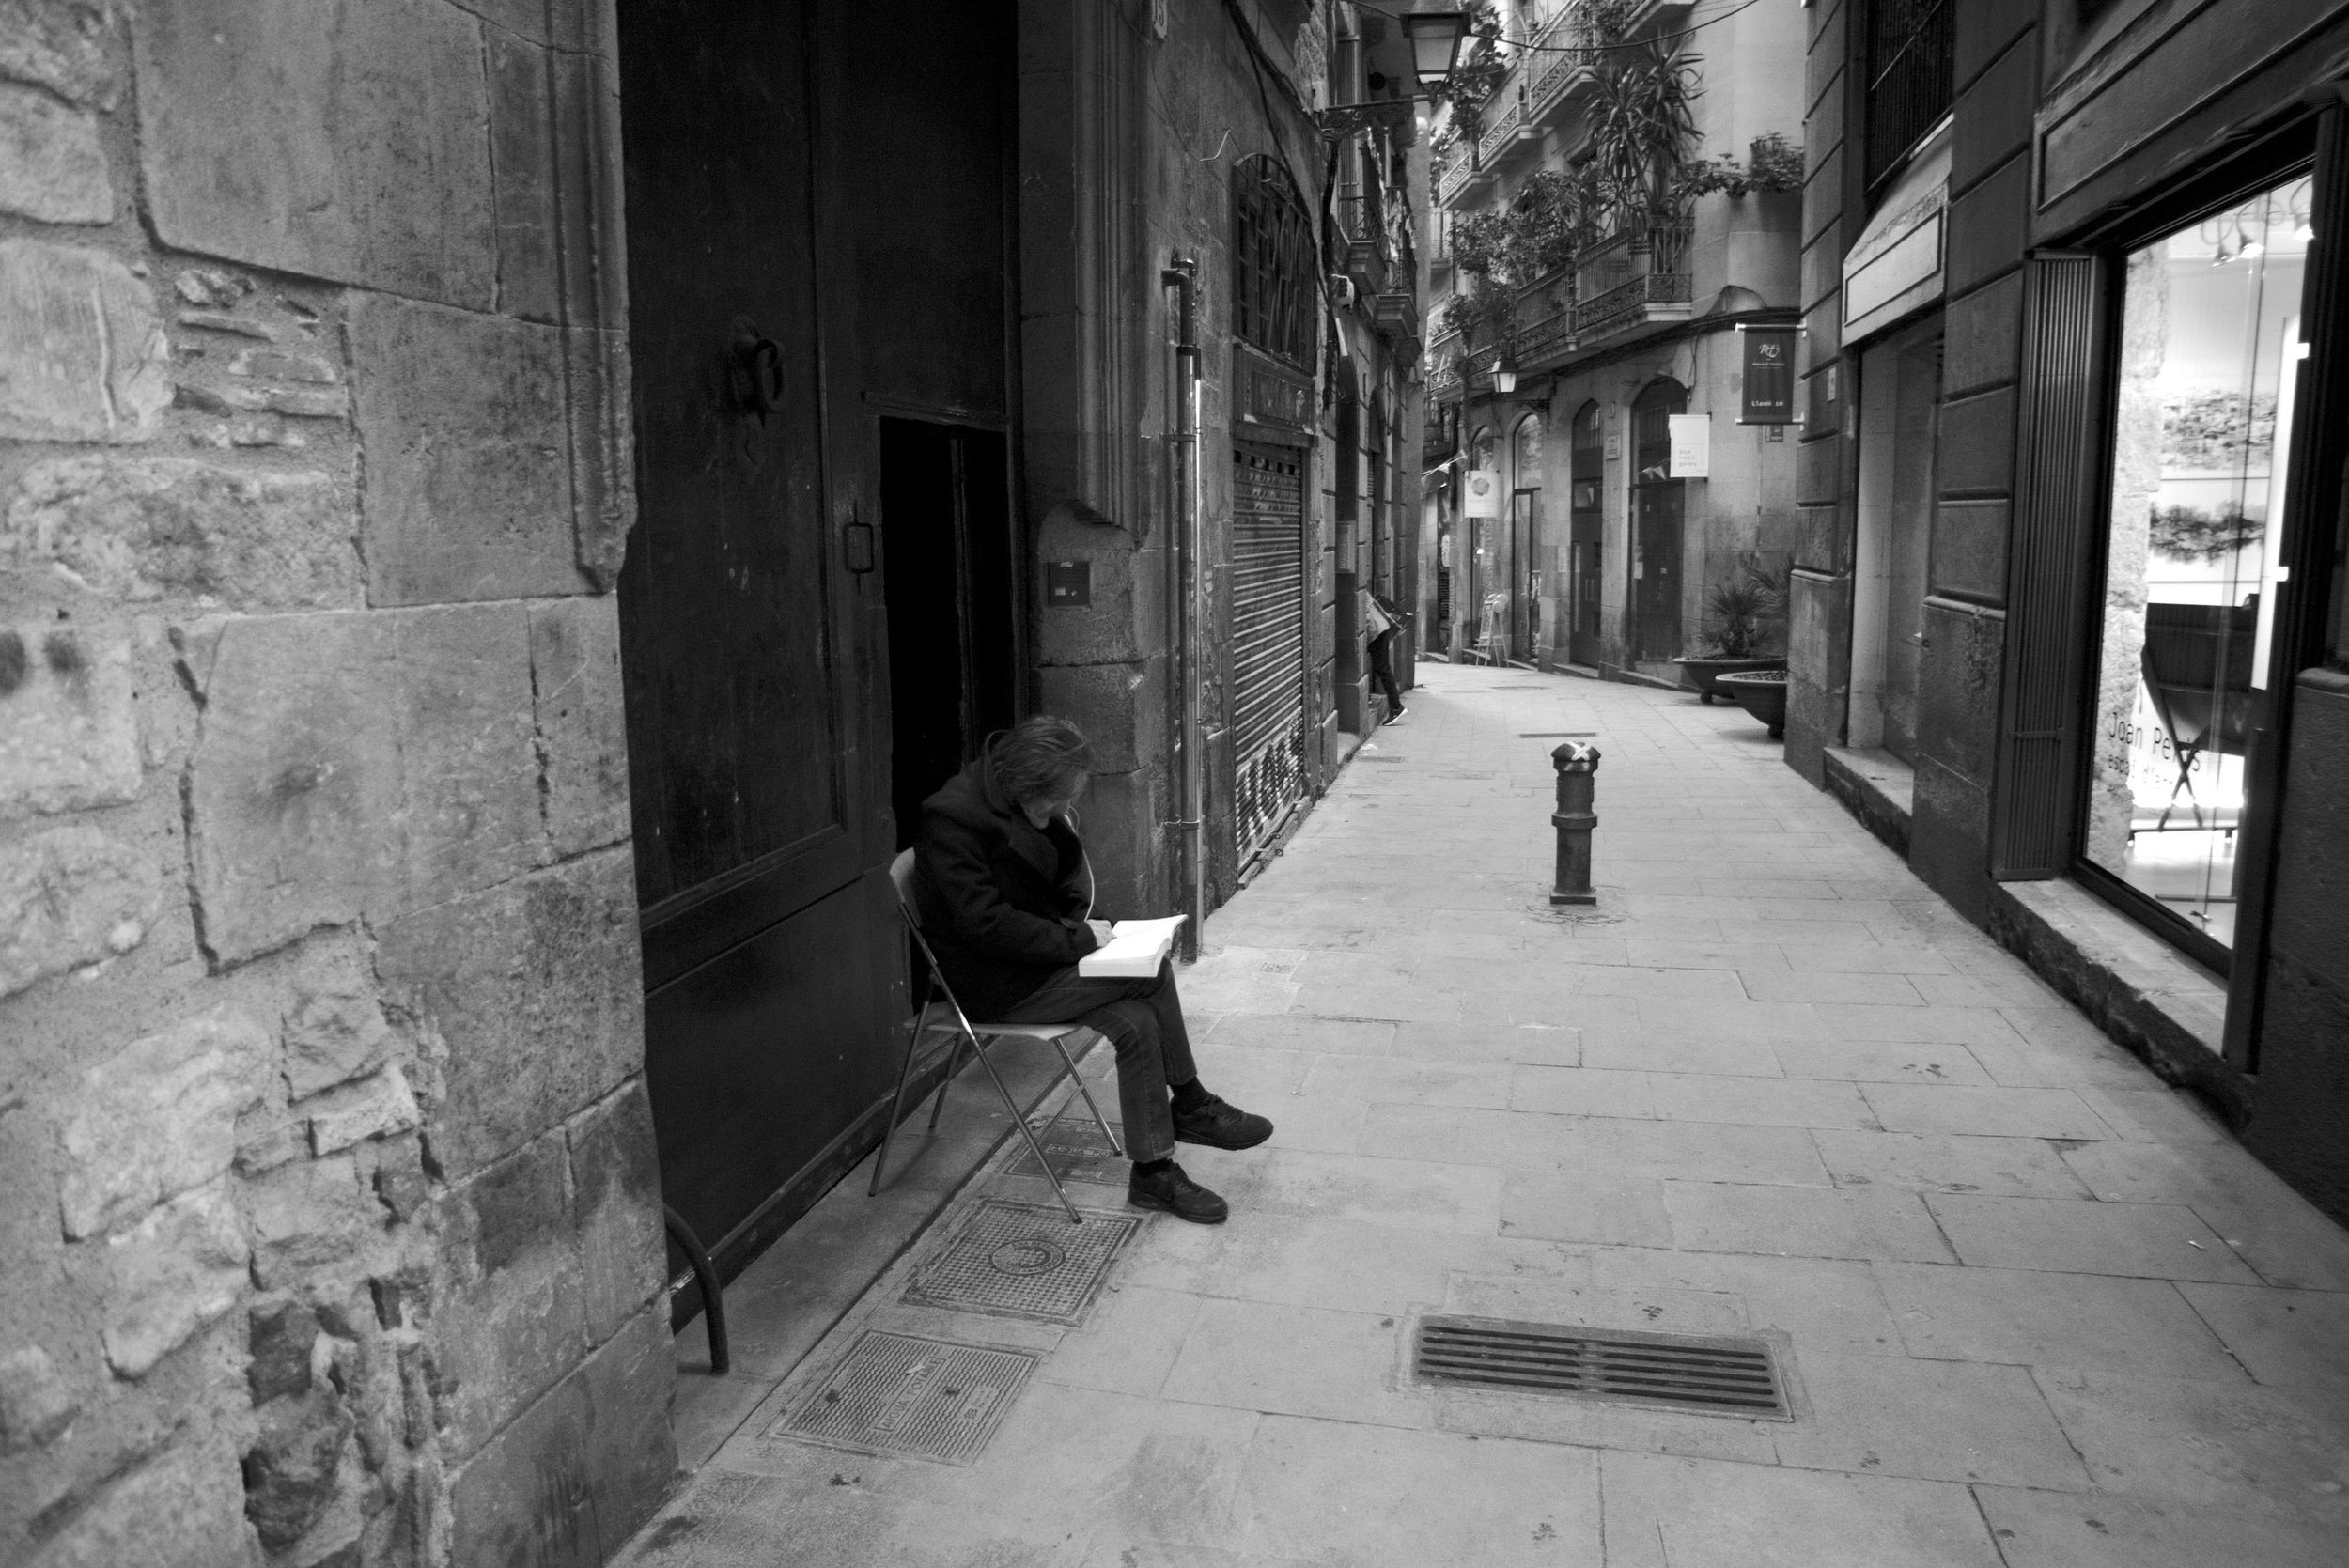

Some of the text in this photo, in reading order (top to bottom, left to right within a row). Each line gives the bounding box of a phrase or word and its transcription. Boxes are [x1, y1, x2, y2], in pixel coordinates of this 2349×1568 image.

[2108, 712, 2201, 772] Joan Pes
[2143, 764, 2173, 788] d'a
[881, 1398, 910, 1428] AIGUA
